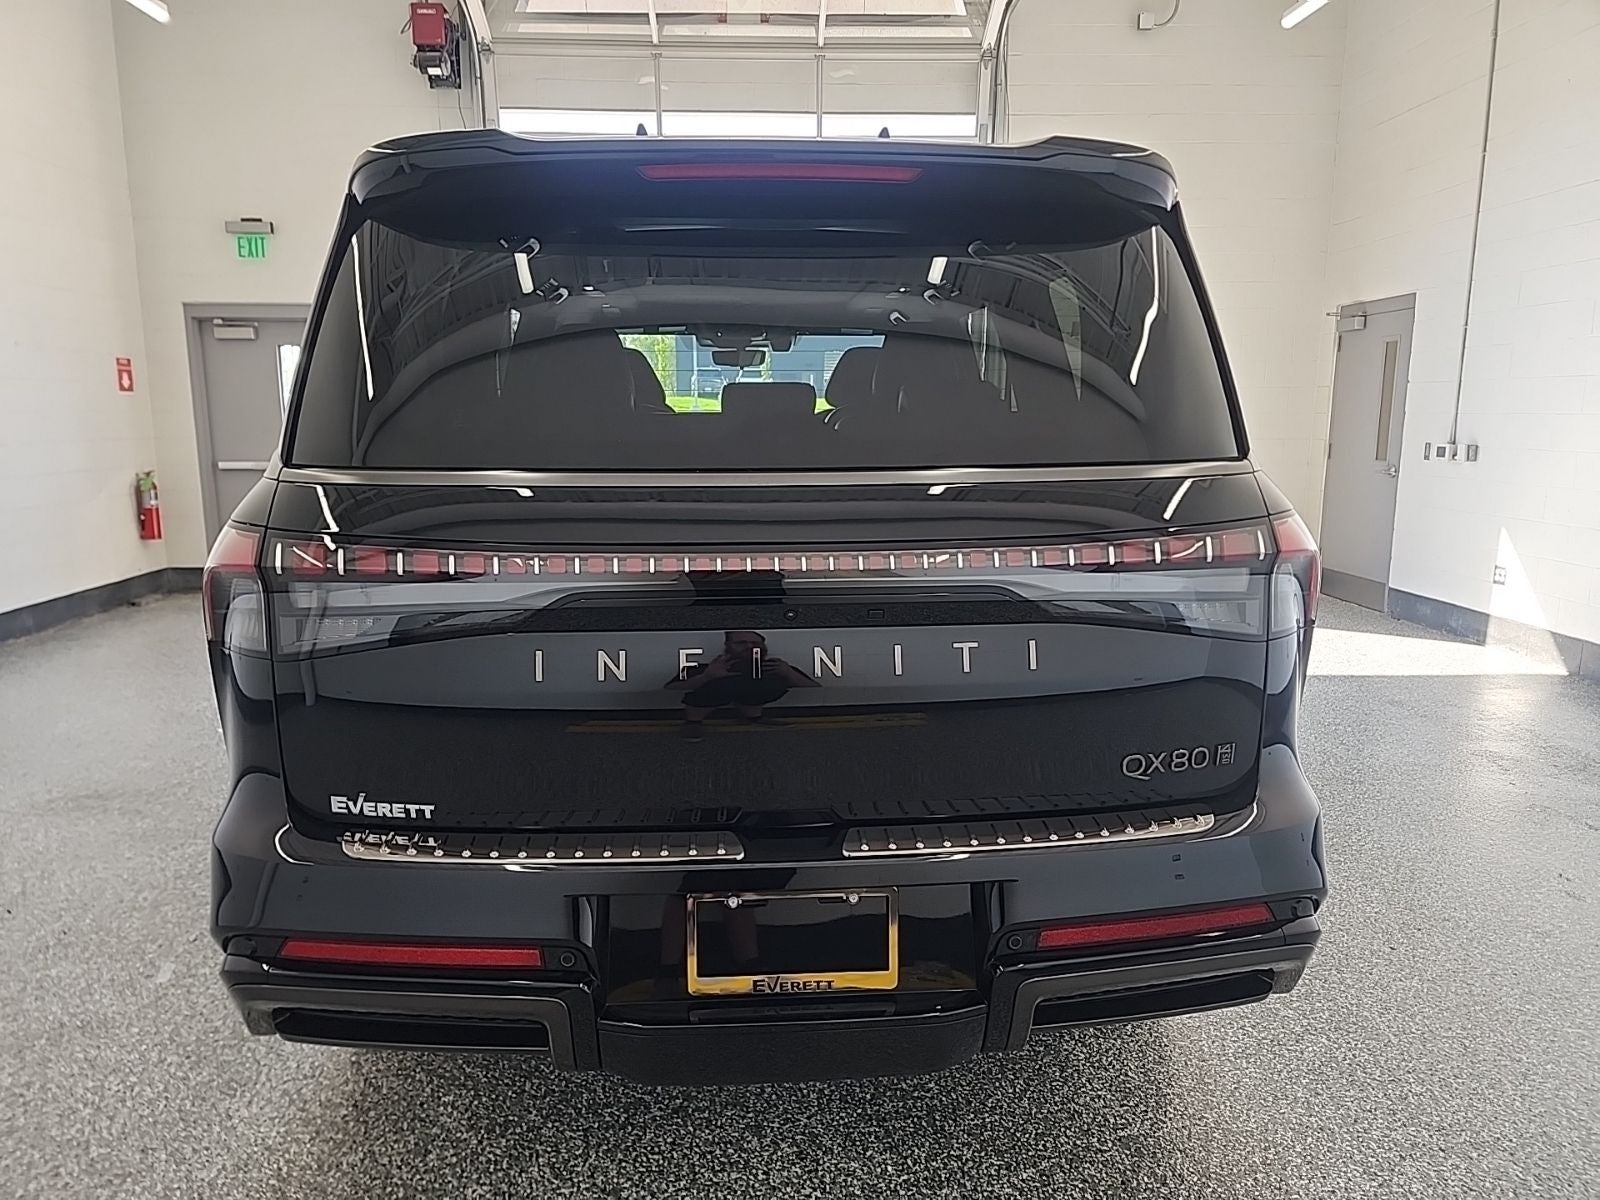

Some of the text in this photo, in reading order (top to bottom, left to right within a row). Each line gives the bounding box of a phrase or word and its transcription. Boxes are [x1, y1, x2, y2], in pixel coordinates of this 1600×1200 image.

[237, 236, 265, 258] EXIT
[534, 639, 1038, 682] INFINITI
[1122, 747, 1209, 780] QX80
[330, 793, 435, 819] EVERETT
[752, 976, 835, 993] EVERETT
